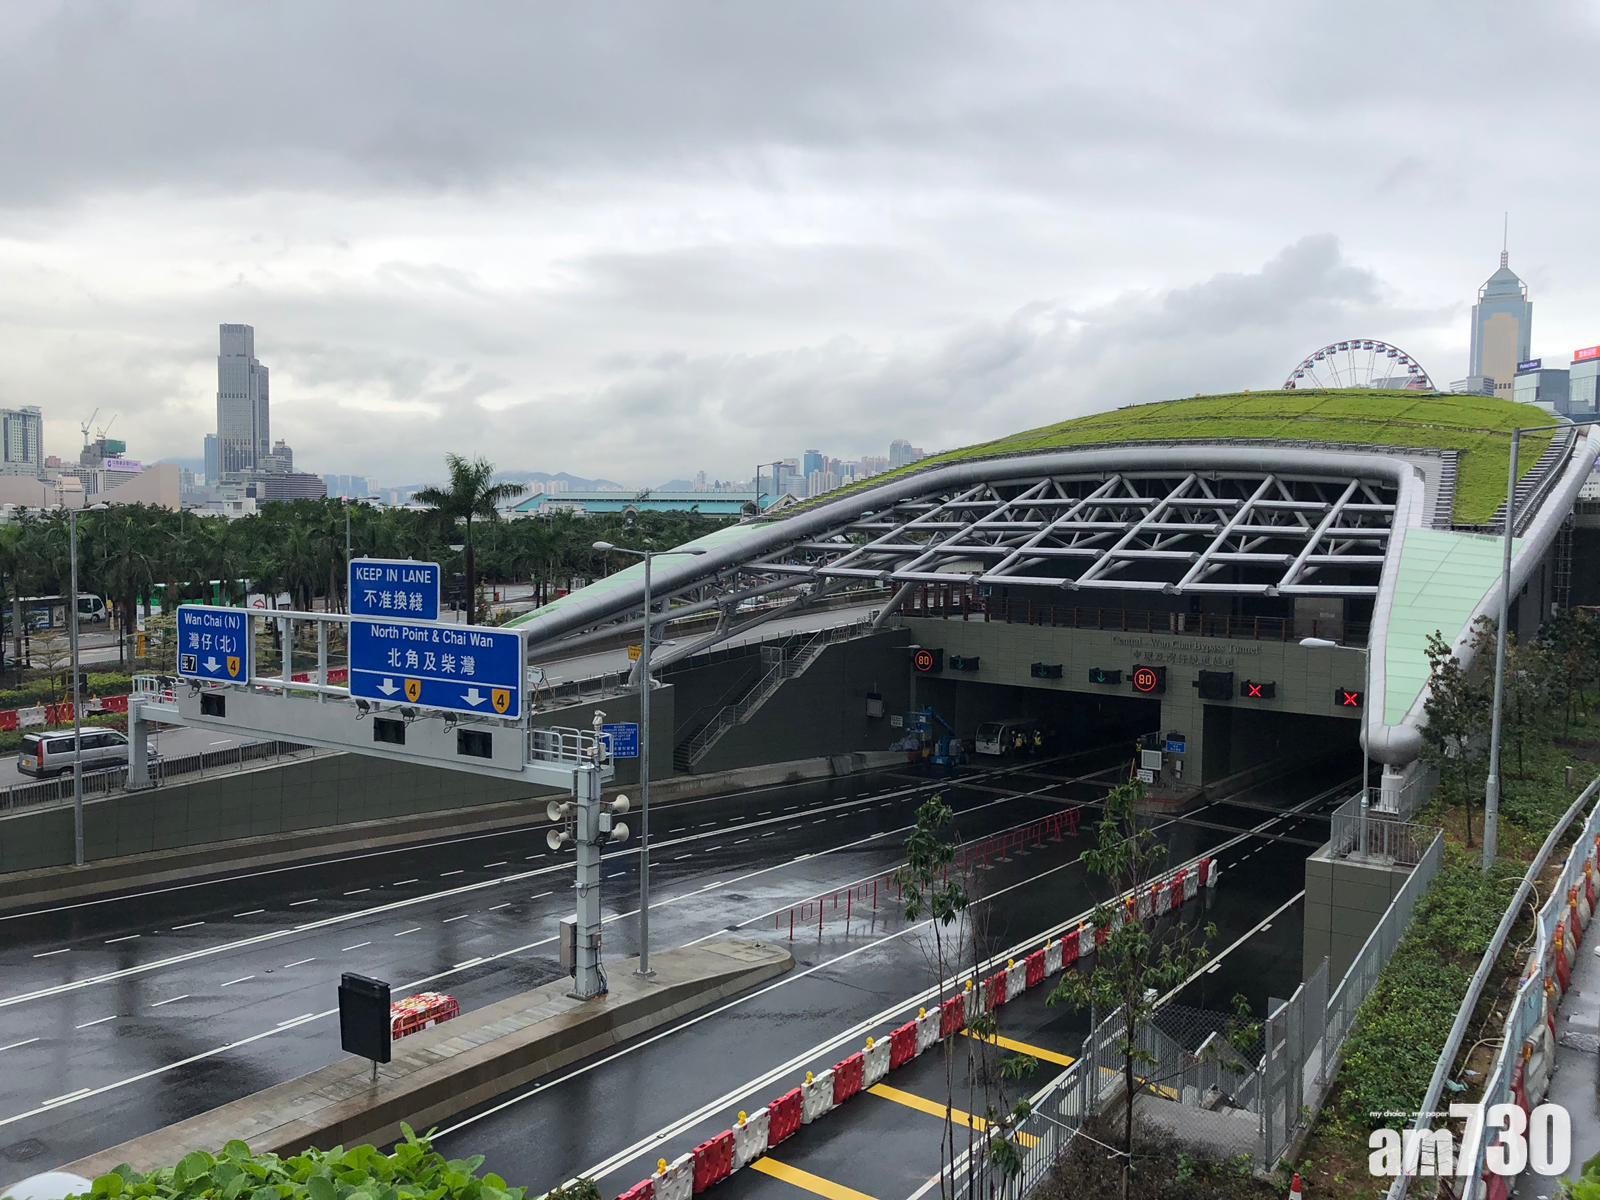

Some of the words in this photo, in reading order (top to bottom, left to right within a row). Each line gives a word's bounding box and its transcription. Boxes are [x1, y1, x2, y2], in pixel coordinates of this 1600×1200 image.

[356, 567, 383, 581] KEEP
[386, 568, 398, 582] IN
[402, 569, 432, 584] LANE
[363, 589, 423, 612] 不准換綫
[184, 612, 202, 625] Wan
[203, 614, 222, 628] Chai
[224, 614, 240, 630] (N)
[371, 624, 399, 639] North
[402, 627, 428, 642] Point
[431, 629, 440, 643] &
[442, 630, 466, 645] Chai
[469, 633, 494, 648] Wan
[190, 656, 195, 671] 7
[230, 660, 237, 672] 4
[387, 647, 476, 676] 北角及柴灣
[918, 656, 929, 665] 80
[1138, 674, 1152, 685] 80
[408, 683, 416, 697] 4
[496, 694, 505, 708] 4
